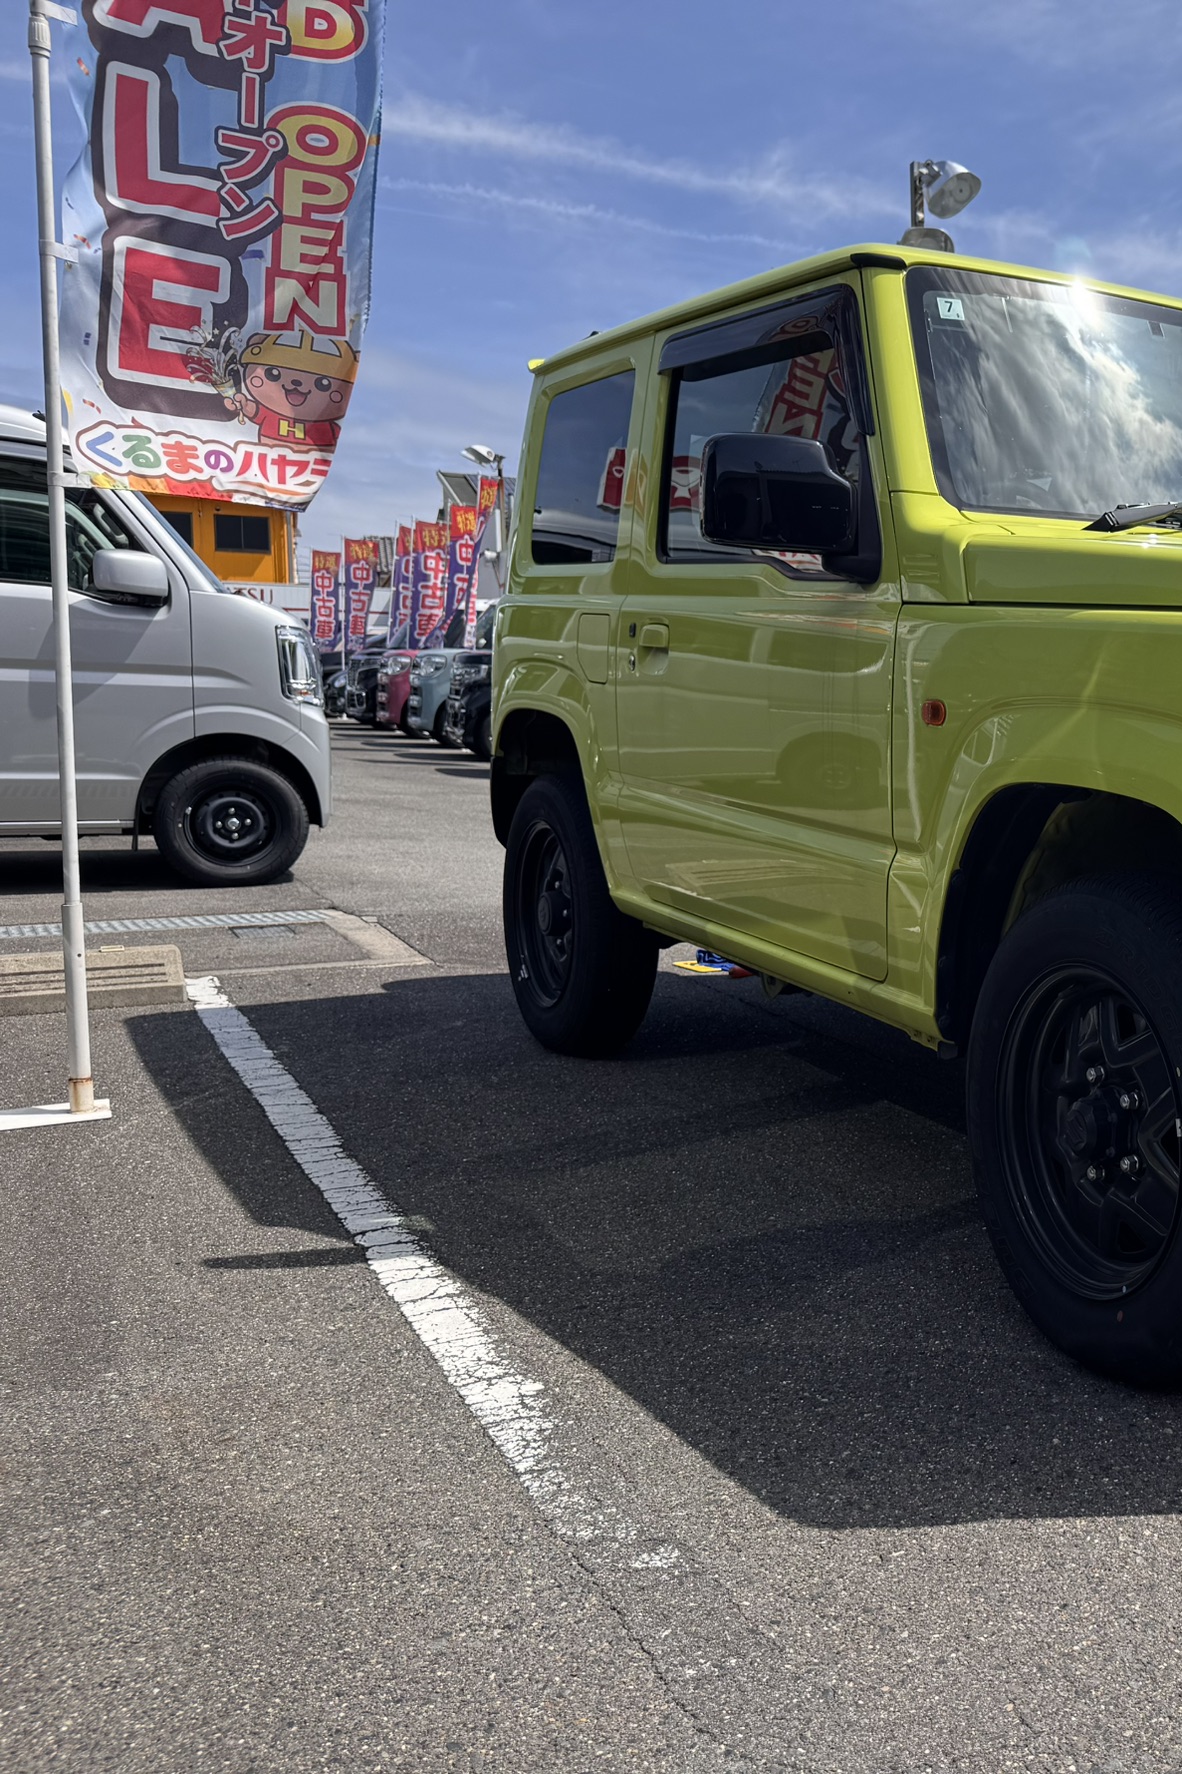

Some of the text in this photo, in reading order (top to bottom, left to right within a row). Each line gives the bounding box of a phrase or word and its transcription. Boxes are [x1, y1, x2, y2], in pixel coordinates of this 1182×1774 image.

[219, 0, 285, 240] オープン
[268, 108, 364, 334] OPEN
[944, 301, 953, 313] 7
[314, 571, 335, 639] 中古車
[349, 561, 373, 637] 中古車
